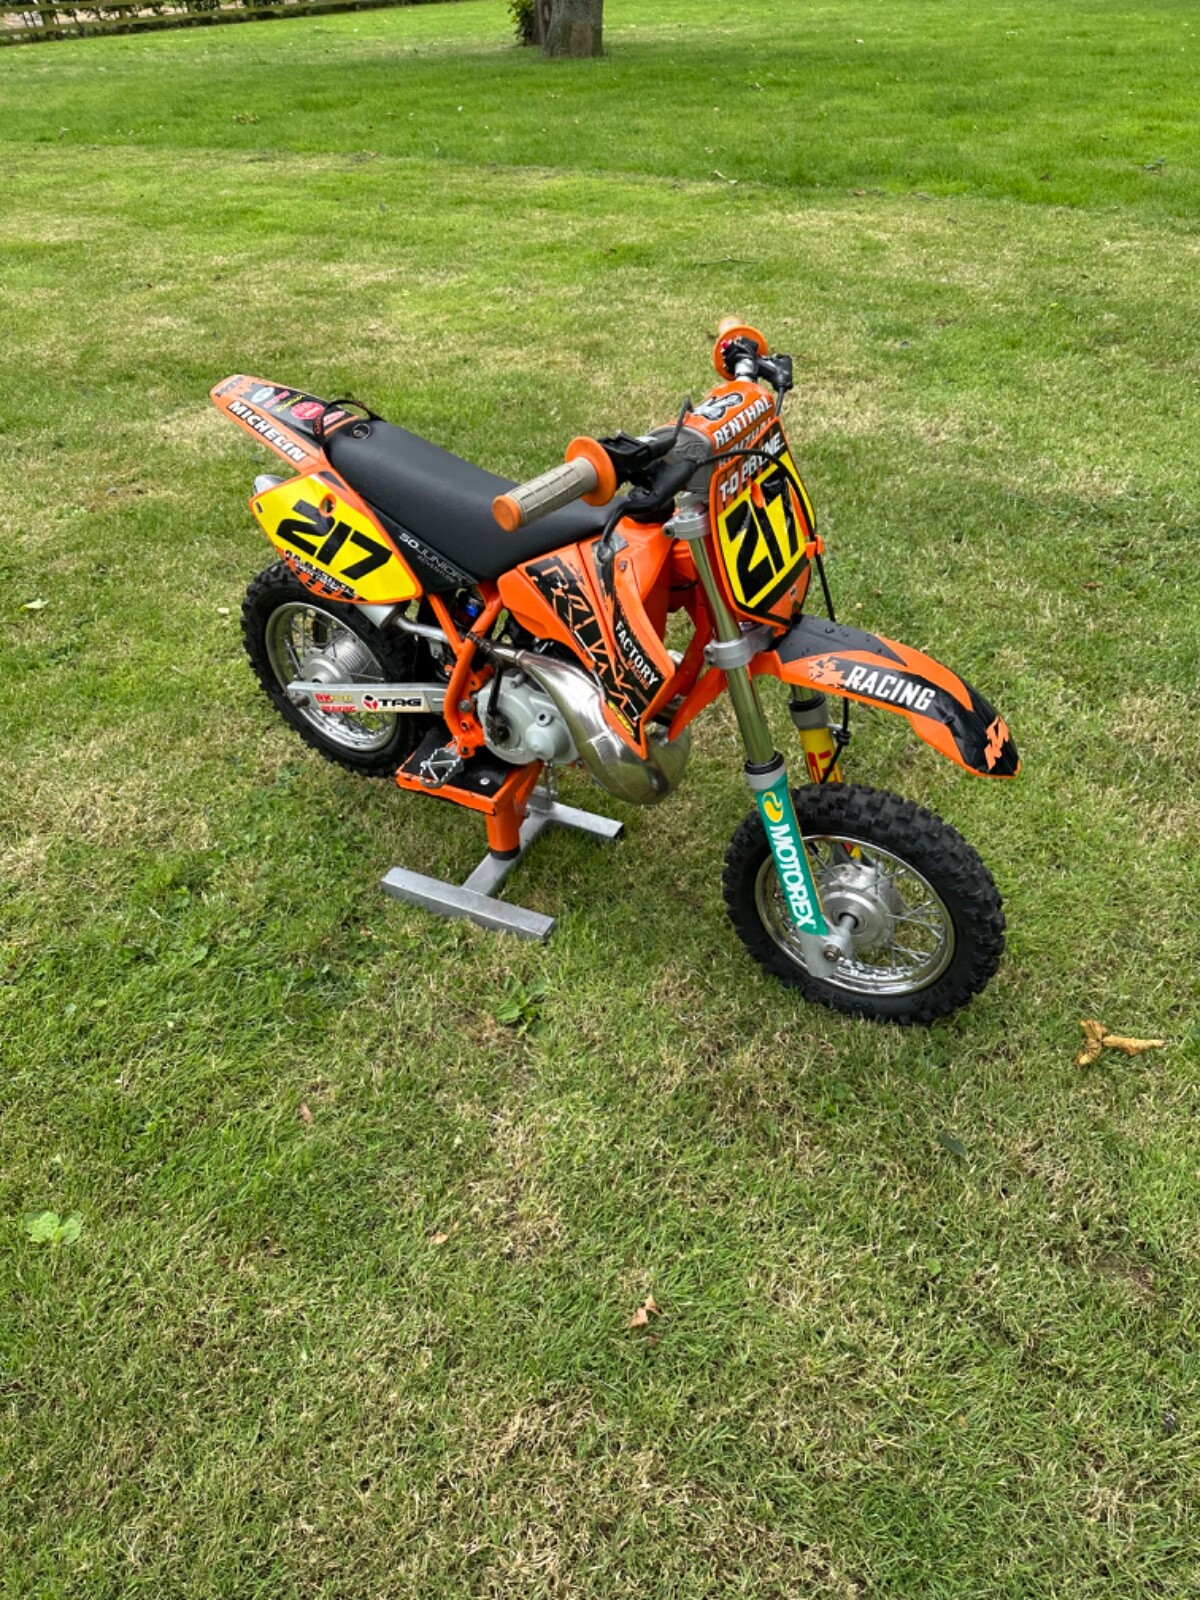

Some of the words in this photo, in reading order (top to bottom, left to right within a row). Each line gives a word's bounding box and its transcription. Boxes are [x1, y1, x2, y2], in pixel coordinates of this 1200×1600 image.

[227, 401, 307, 462] MICHELIN
[712, 394, 772, 449] RENTHAL
[276, 499, 392, 581] 217
[725, 466, 799, 604] 217
[615, 620, 659, 684] FACTORY
[378, 697, 421, 707] TAG
[844, 665, 936, 711] RACING
[769, 823, 816, 928] MOTOREX
